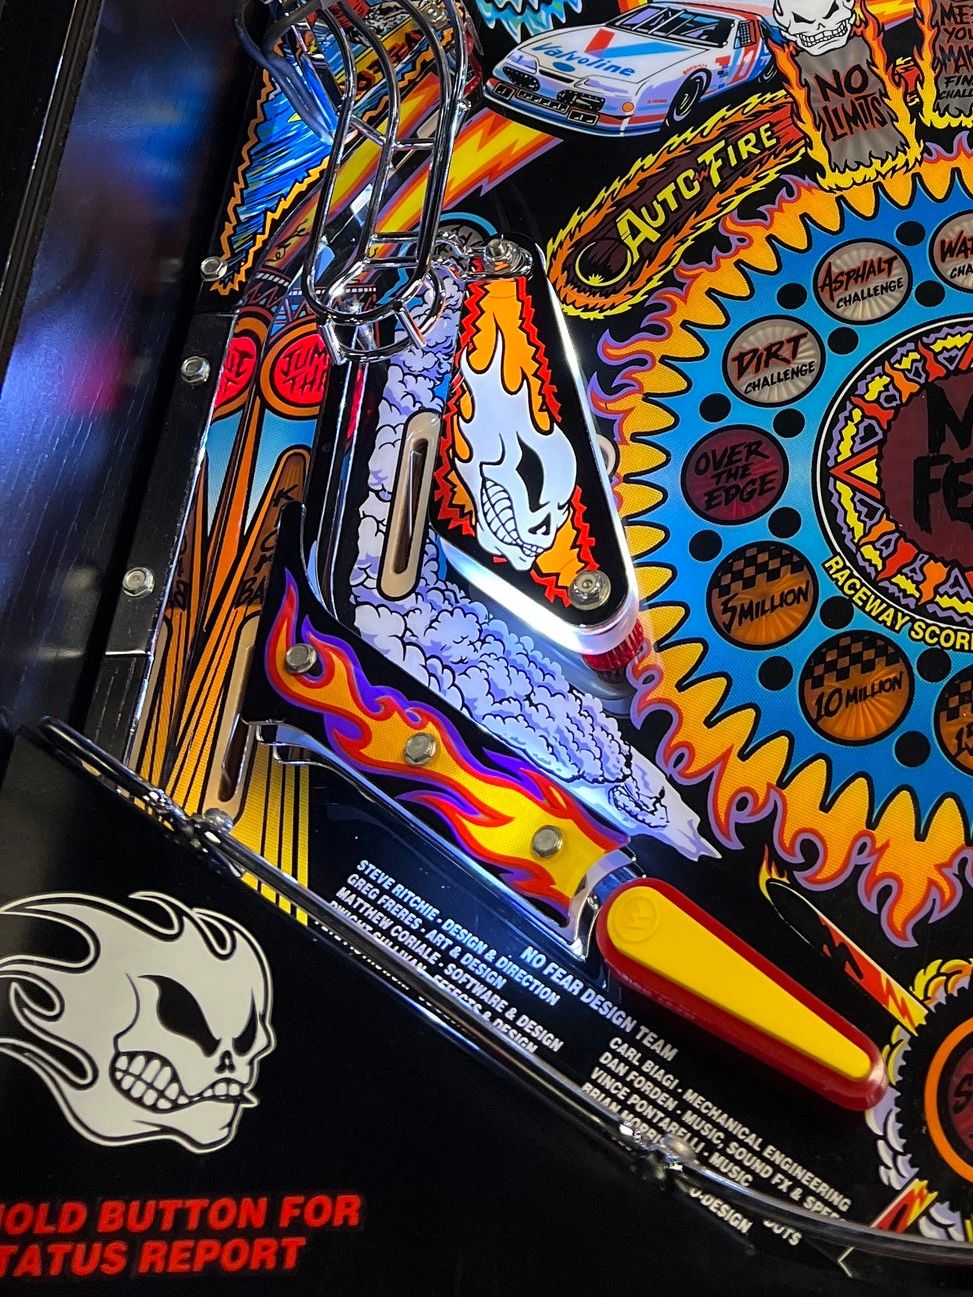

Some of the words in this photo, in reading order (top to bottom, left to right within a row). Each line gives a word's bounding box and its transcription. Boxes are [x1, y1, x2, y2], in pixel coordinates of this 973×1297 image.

[531, 43, 636, 78] Valvoline
[816, 64, 870, 103] NO
[819, 98, 885, 141] LIMITS
[818, 255, 898, 303] ASPHALT
[835, 277, 904, 310] CHALLENGE
[731, 332, 808, 382] DIRT
[743, 360, 817, 395] CHALLENGE
[694, 439, 769, 476] OVER
[710, 461, 753, 486] THE
[704, 470, 778, 512] EDGE
[720, 593, 740, 634] 5
[738, 580, 812, 626] MILLION
[824, 556, 910, 632] RACEWAY
[813, 688, 844, 721] 10
[845, 672, 904, 705] MILLION
[346, 873, 378, 901] GREG
[377, 893, 421, 931] FRERES
[424, 928, 452, 952] ART
[460, 951, 507, 991] DESIGN
[356, 859, 394, 889] STEVE
[391, 881, 437, 922] RITCHIE
[442, 918, 485, 955] DESIGN
[496, 953, 561, 1006] DIRECTION
[335, 887, 392, 933] MATTHEW
[388, 925, 440, 966] CORIALE
[443, 963, 508, 1013] SOFTWARE
[516, 1013, 564, 1052] DESIGN
[520, 946, 546, 969] NO
[543, 962, 583, 997] FEAR
[580, 989, 635, 1034] DESIGN
[635, 1025, 679, 1062] TEAM
[590, 1066, 628, 1100] VINCE
[707, 1152, 755, 1189] MUSIC
[598, 1052, 626, 1077] DAN
[626, 1071, 678, 1114] FORDEN
[684, 1110, 725, 1148] MUSIC,
[725, 1142, 773, 1180] SOUND
[772, 1173, 790, 1193] FX
[609, 1037, 642, 1064] CARL
[642, 1059, 679, 1090] BIAGI
[683, 1089, 762, 1151] MECHANICAL
[762, 1145, 852, 1211] ENGINEERING
[97, 1196, 268, 1233] BUTTON
[278, 1194, 361, 1228] FOR
[0, 1241, 129, 1277] TATUS
[137, 1237, 306, 1273] REPORT
